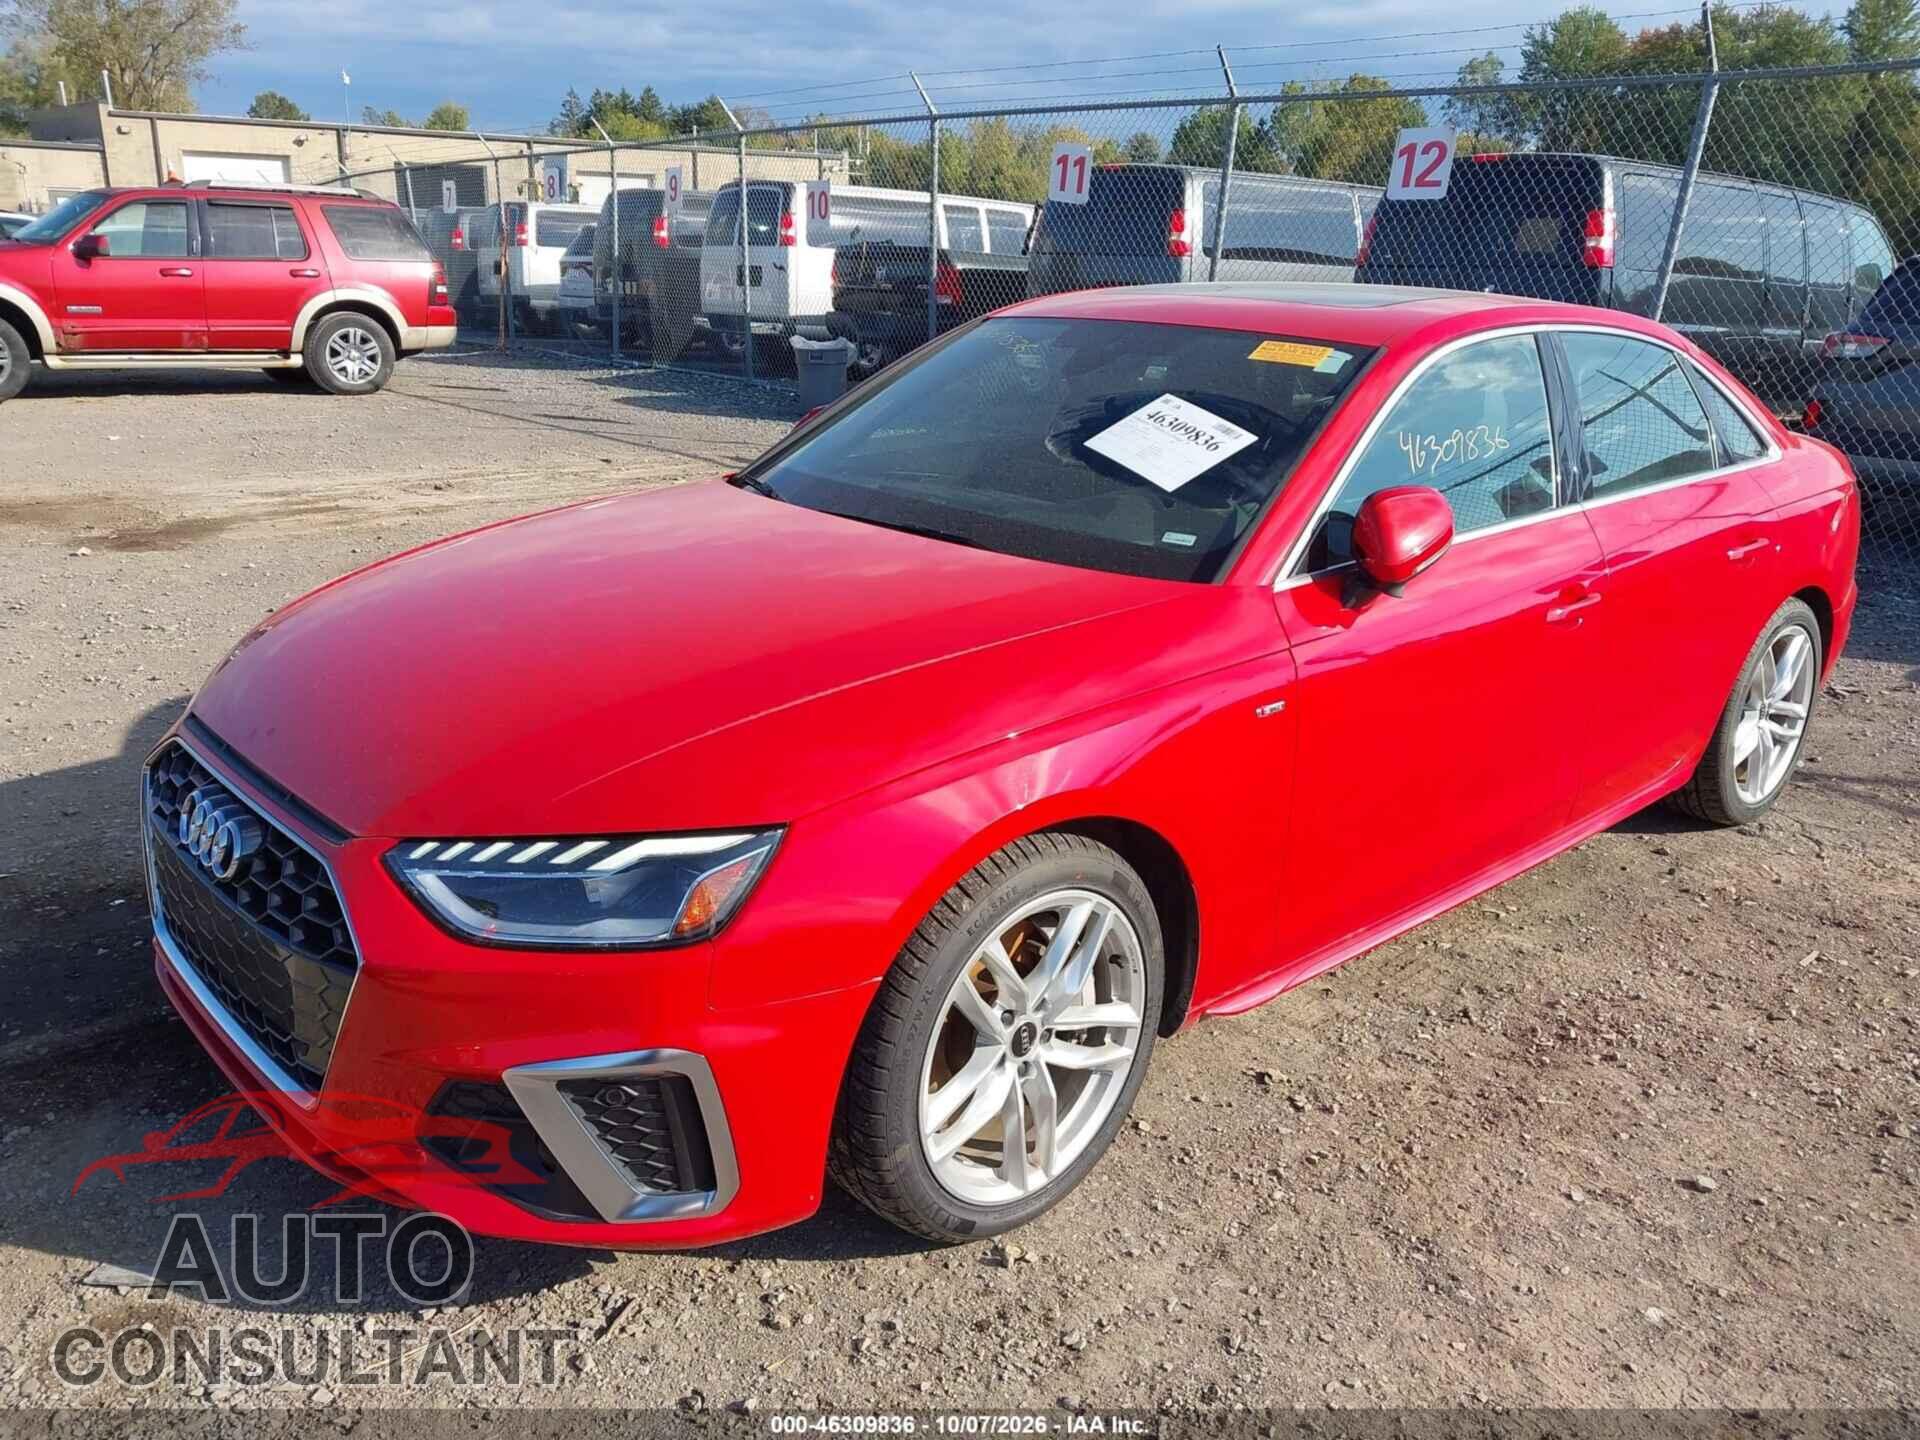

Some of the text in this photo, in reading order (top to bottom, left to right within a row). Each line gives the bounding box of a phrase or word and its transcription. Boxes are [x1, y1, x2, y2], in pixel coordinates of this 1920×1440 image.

[1056, 154, 1087, 194] 11
[1397, 140, 1448, 188] 12
[546, 175, 556, 200] 8
[668, 174, 678, 202] 9
[807, 190, 829, 220] 10
[1146, 410, 1225, 452] 46309836
[1399, 425, 1510, 474] 46309836
